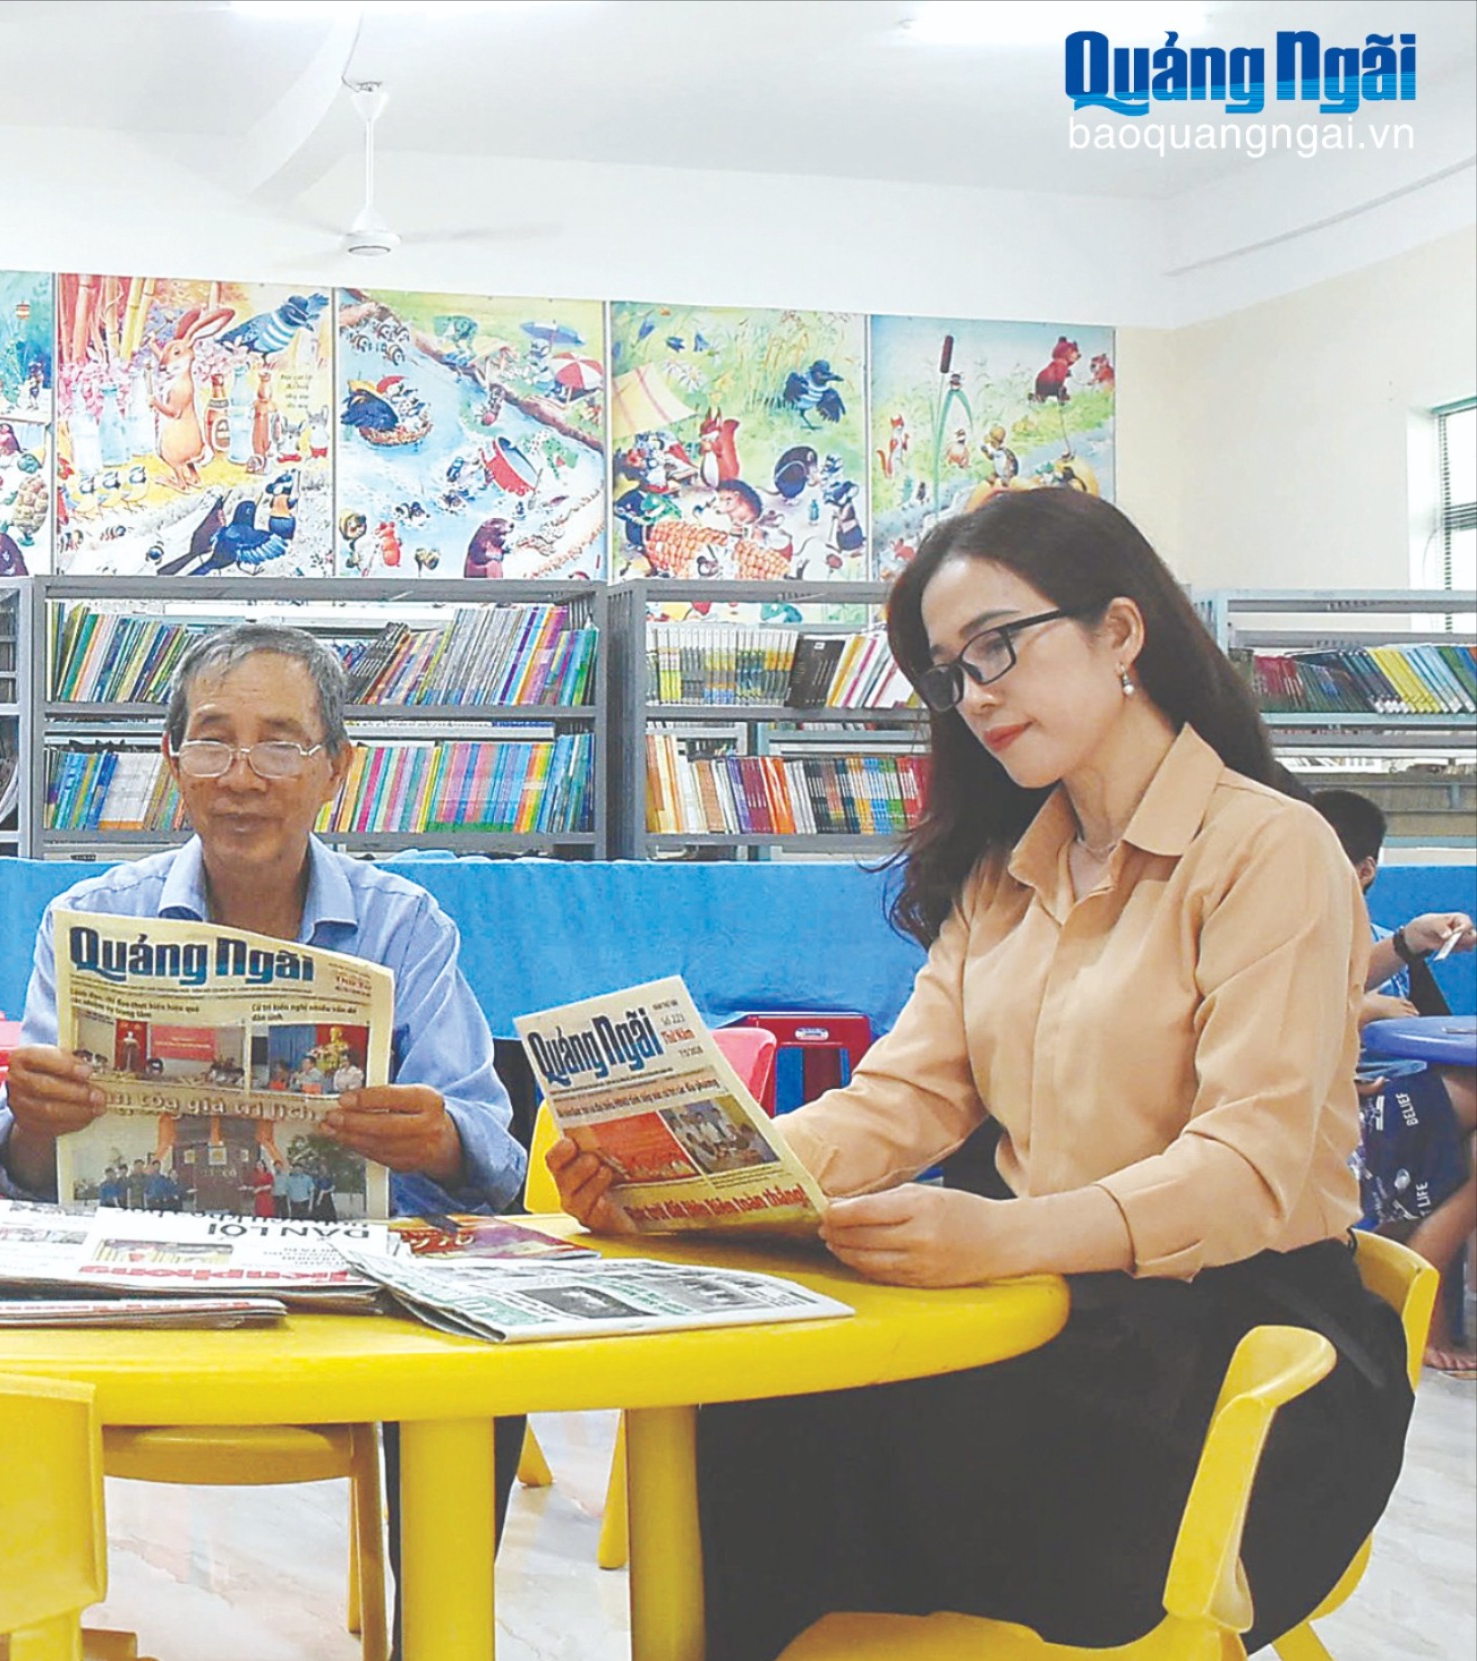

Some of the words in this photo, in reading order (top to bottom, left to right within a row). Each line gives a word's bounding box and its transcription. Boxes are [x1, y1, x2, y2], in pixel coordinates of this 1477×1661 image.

[70, 926, 208, 986] Quảng
[216, 937, 314, 985] Ngãi
[527, 1025, 610, 1087] Quảng
[592, 1007, 665, 1071] Ngãi
[1396, 1092, 1419, 1126] BELIEF
[1415, 1182, 1432, 1208] LIFE
